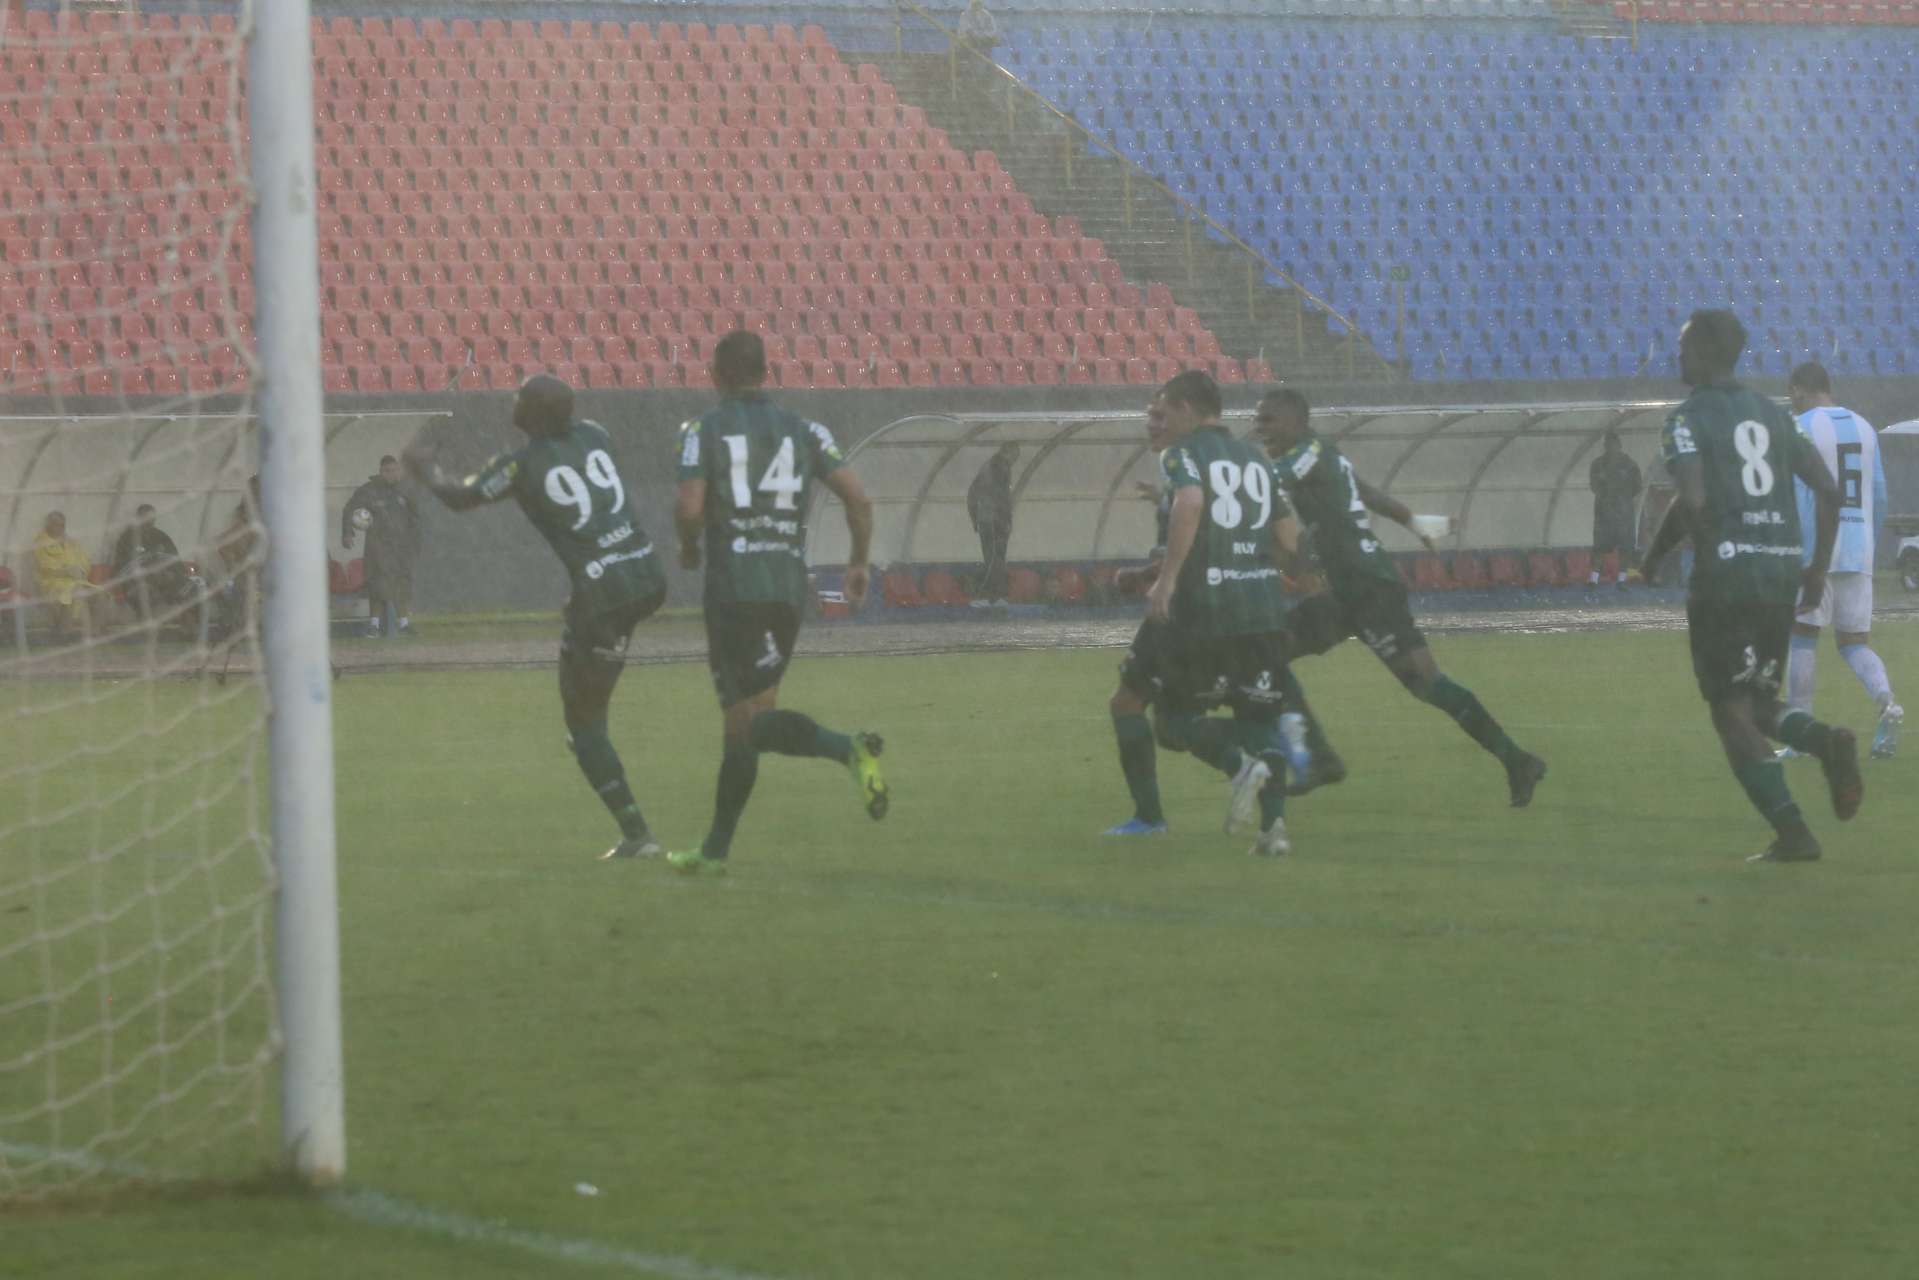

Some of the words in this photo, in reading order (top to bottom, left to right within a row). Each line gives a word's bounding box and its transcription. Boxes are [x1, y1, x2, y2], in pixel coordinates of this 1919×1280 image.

[544, 449, 625, 530] 99
[722, 435, 803, 510] 14
[1208, 460, 1271, 530] 89
[1734, 420, 1773, 496] 8
[1837, 443, 1862, 508] 6
